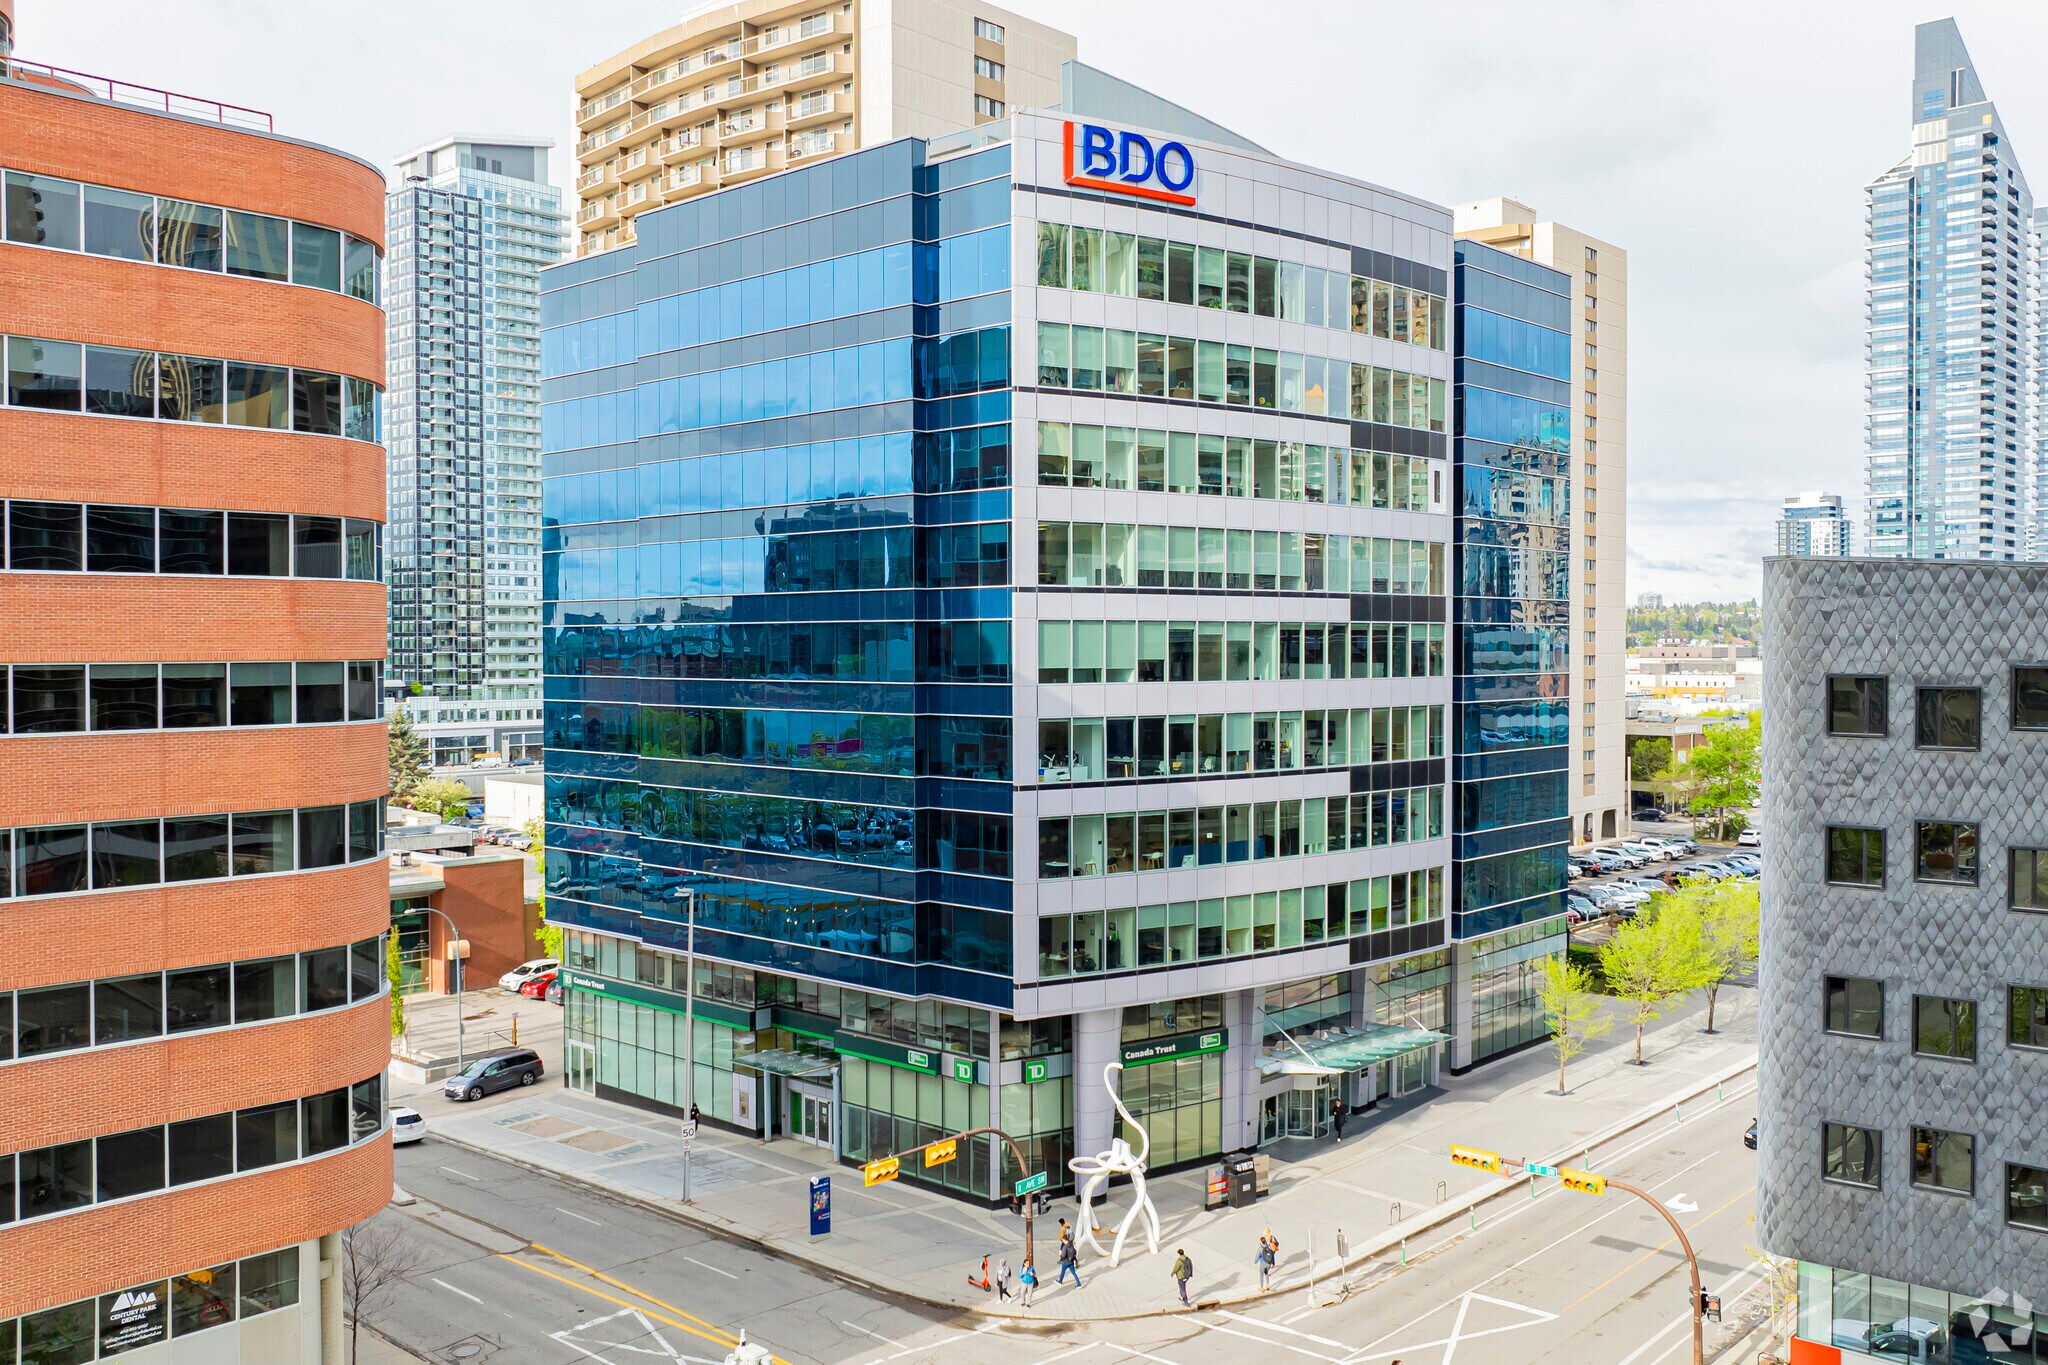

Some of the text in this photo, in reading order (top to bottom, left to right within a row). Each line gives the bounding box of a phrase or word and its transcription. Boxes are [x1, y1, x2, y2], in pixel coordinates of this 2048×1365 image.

[1083, 124, 1194, 191] BDO
[573, 977, 605, 990] Canada Trust
[1125, 1044, 1176, 1059] Canada Trust
[956, 1063, 971, 1078] TD
[1028, 1064, 1044, 1079] TD
[683, 1128, 694, 1137] 50
[1026, 1179, 1035, 1190] AVE
[110, 1304, 157, 1320] CENTURY PARK
[121, 1313, 147, 1324] DENTAL
